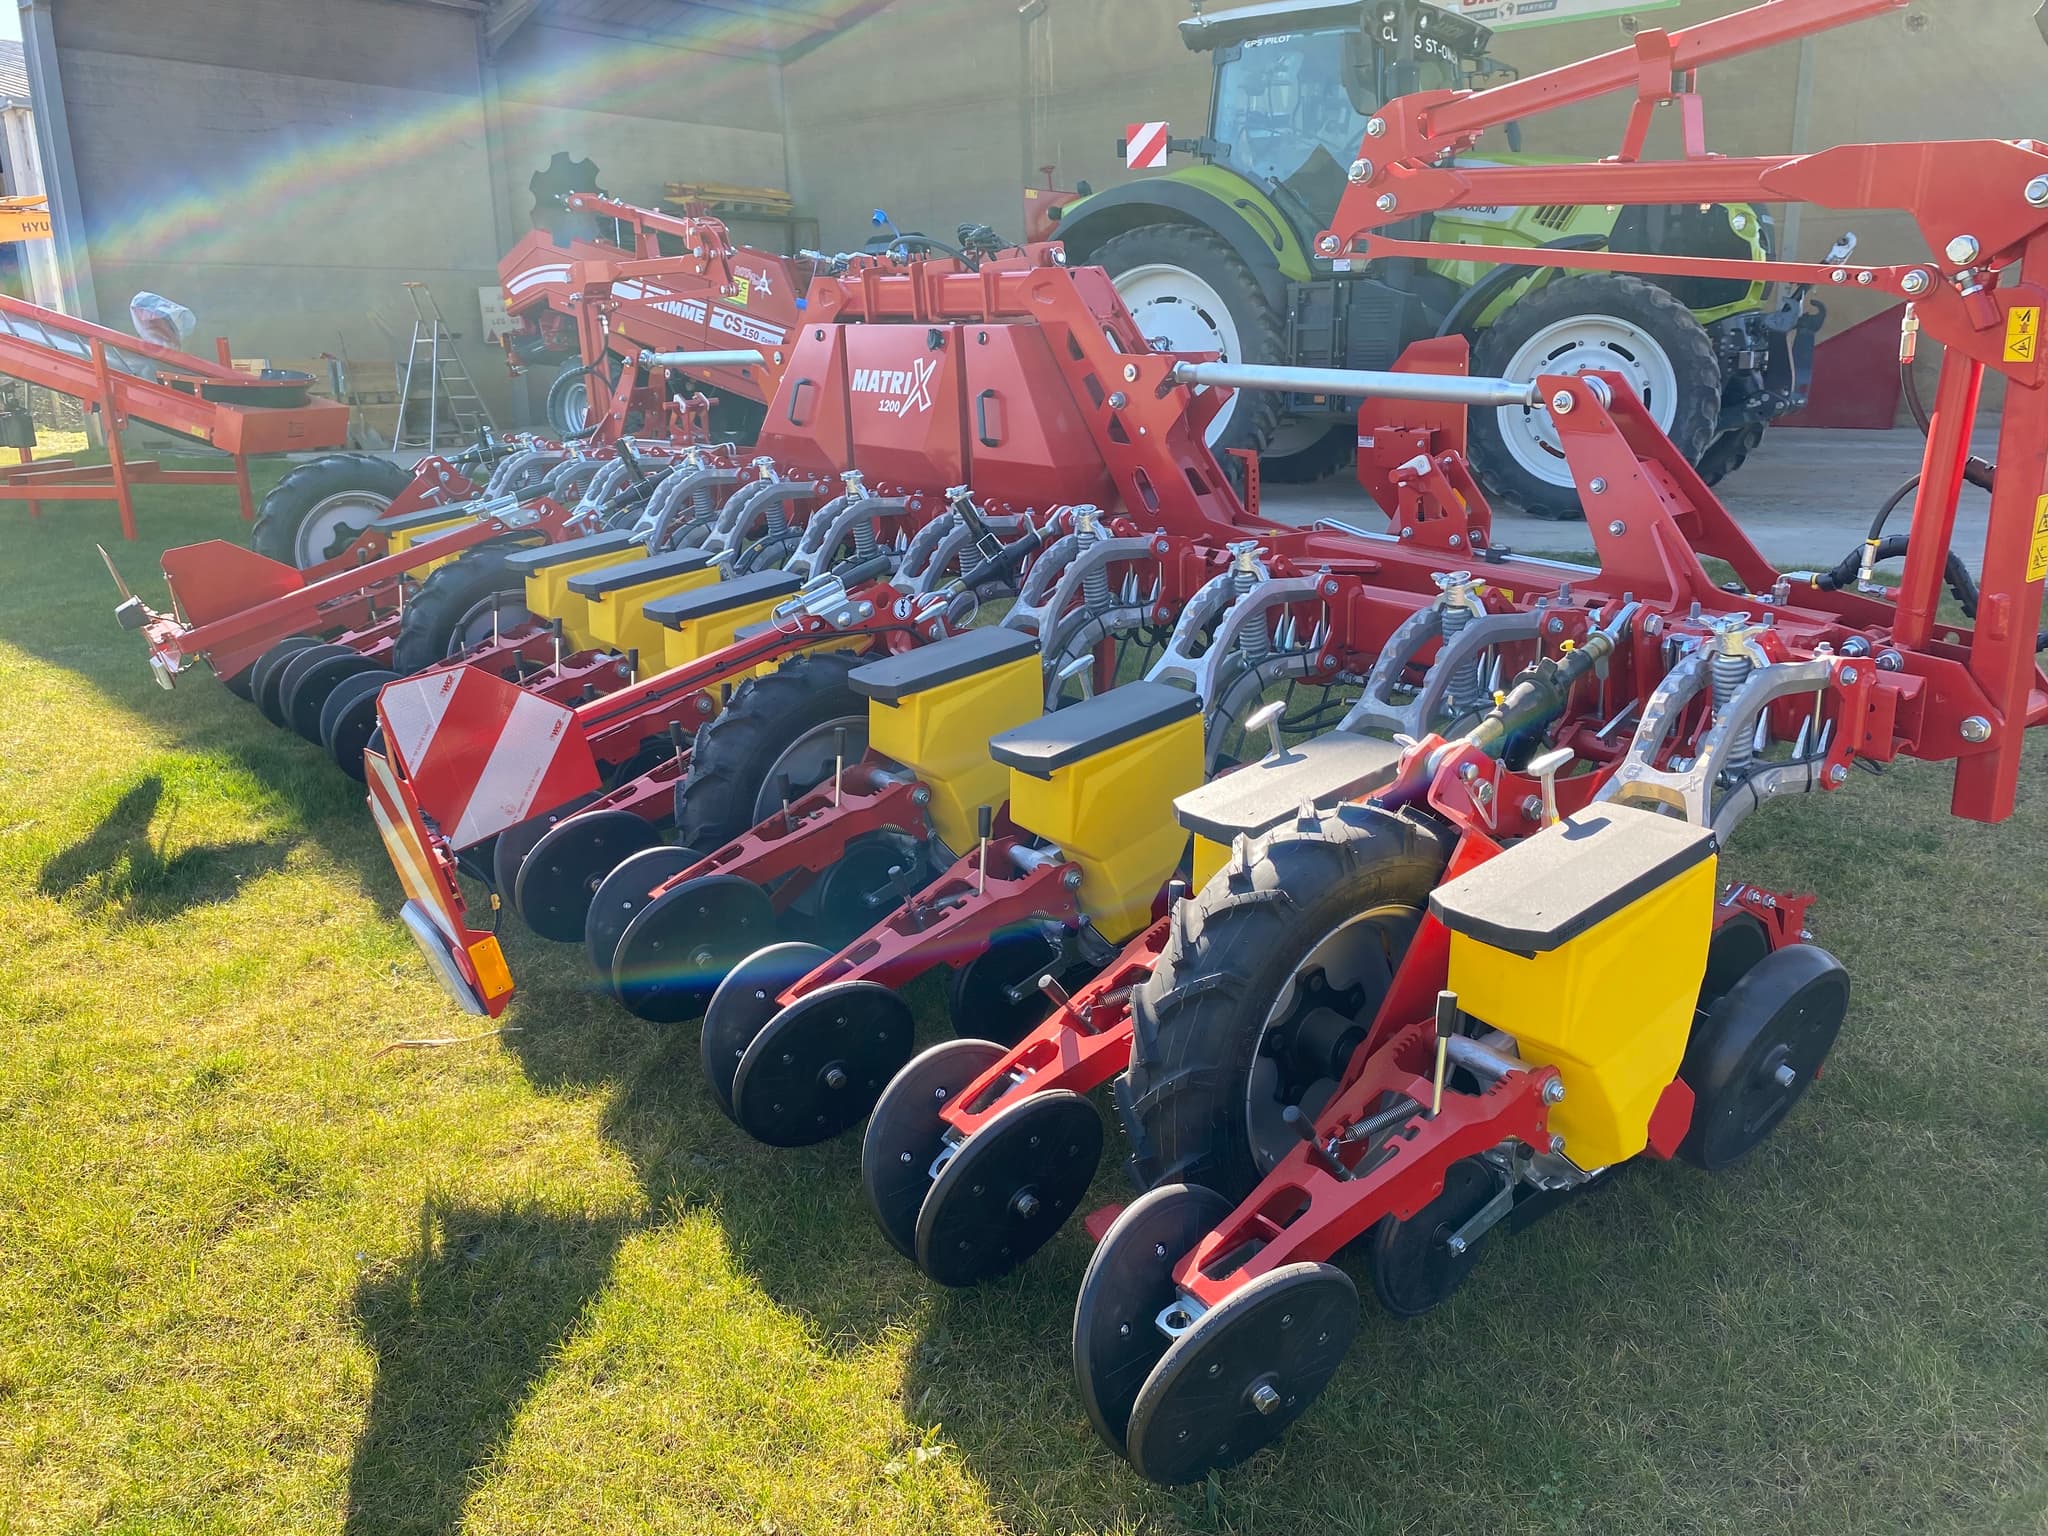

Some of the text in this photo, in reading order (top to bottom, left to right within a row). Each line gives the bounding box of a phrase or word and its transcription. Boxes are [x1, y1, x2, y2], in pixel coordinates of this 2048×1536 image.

[1244, 35, 1291, 48] GPS PILOT
[1383, 26, 1422, 49] CLS
[647, 301, 706, 324] RIMME
[723, 313, 742, 333] CS
[743, 327, 759, 341] 150
[852, 358, 937, 418] MATRIX
[878, 399, 900, 413] 1200
